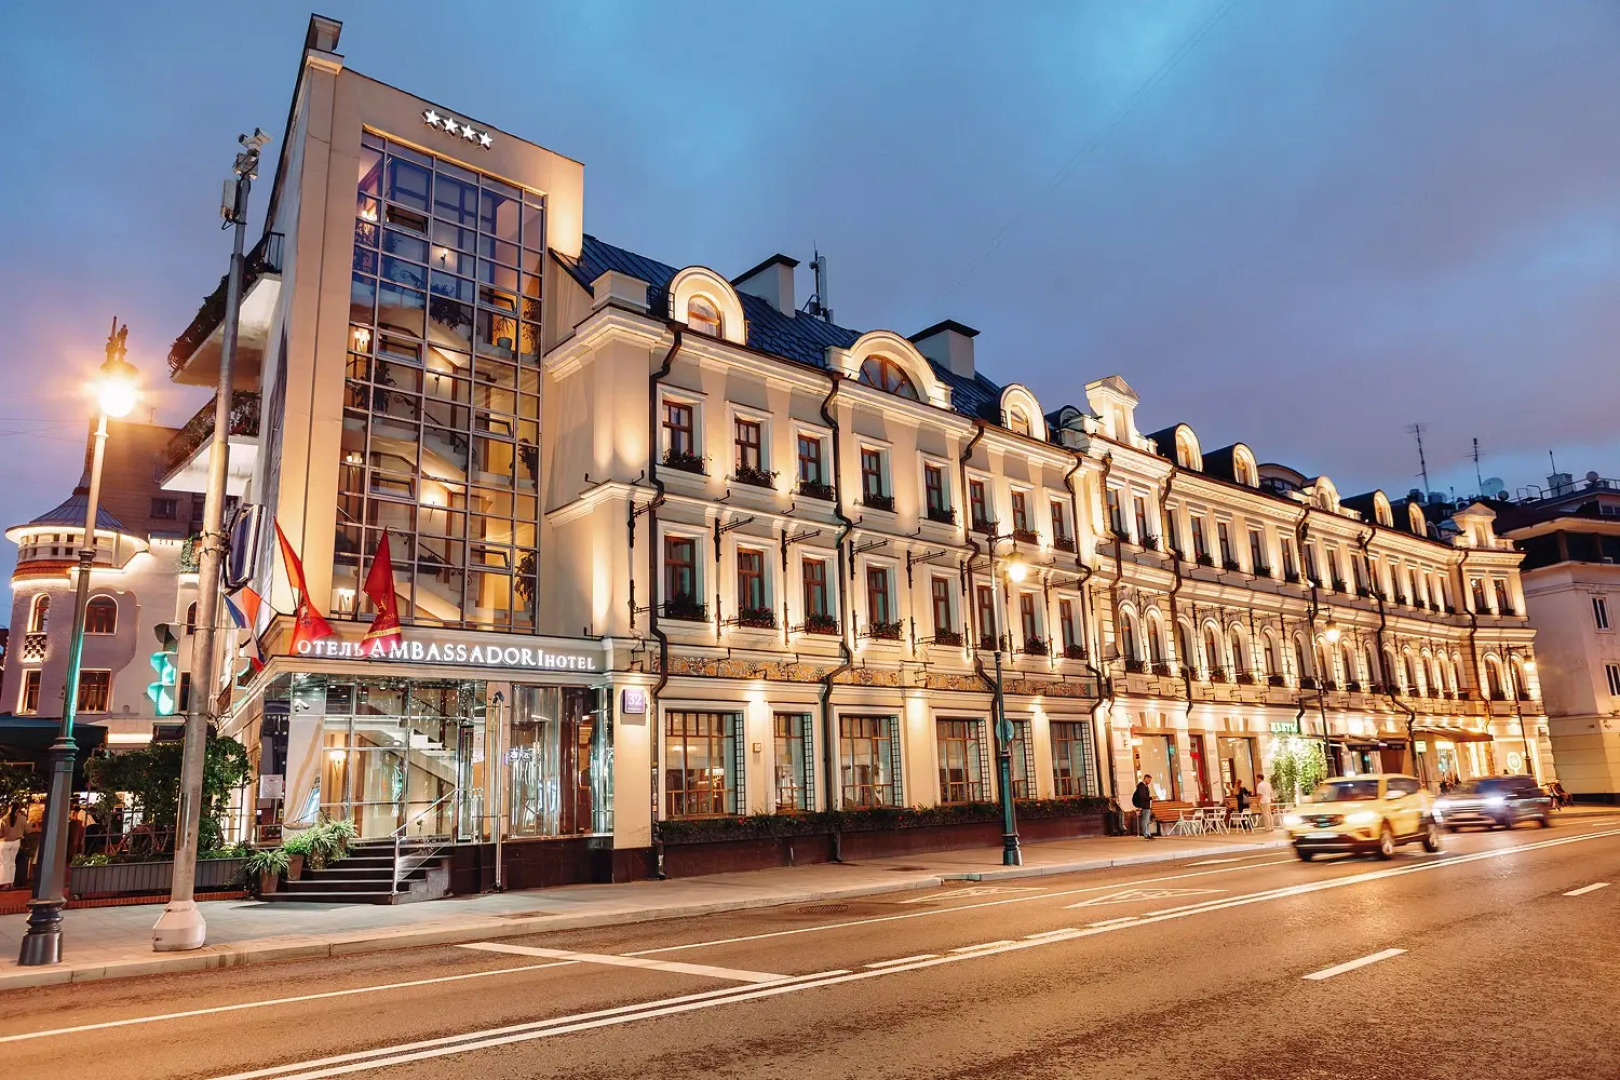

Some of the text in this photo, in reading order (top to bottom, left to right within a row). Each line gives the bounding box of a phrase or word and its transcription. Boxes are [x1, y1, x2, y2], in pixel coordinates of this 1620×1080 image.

[297, 638, 596, 670] ОТЕЛЬ AMBASSADORI HOTEL
[628, 694, 643, 706] 32
